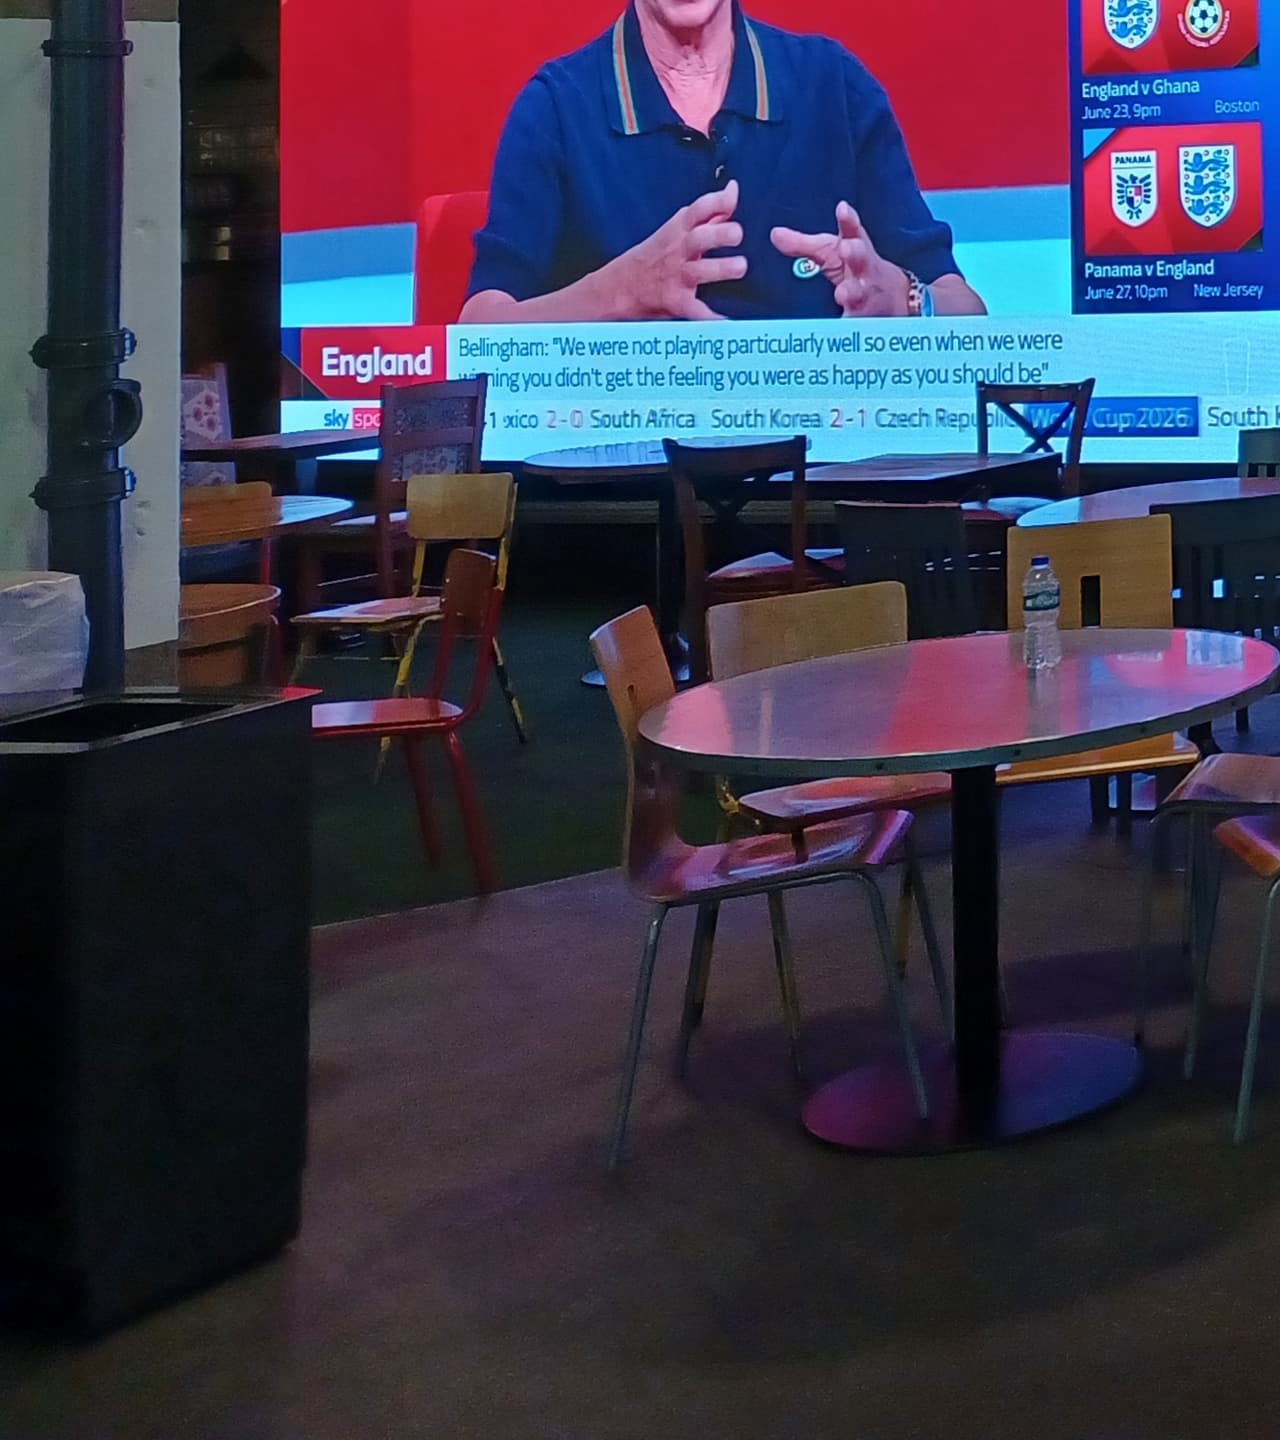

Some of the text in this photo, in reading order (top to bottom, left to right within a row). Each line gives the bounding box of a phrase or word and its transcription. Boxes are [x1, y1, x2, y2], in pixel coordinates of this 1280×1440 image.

[1082, 79, 1200, 101] England v Ghana
[1081, 106, 1110, 120] June
[1133, 103, 1161, 120] 9pm
[1215, 99, 1260, 113] Boston
[1084, 259, 1215, 280] Panama v England
[1084, 286, 1114, 300] June
[1135, 284, 1168, 300] 10pm
[1193, 283, 1264, 300] New Jersey
[459, 331, 1063, 362] Bellingham: "We were not playing particularly well so even when we were
[321, 346, 432, 383] England
[524, 373, 552, 392] you
[554, 366, 602, 387] didn't
[606, 369, 632, 392] get
[636, 367, 665, 387] the
[668, 366, 725, 392] feeling
[728, 371, 759, 391] you
[762, 369, 805, 386] were
[808, 369, 829, 385] as
[833, 364, 888, 390] happy
[891, 368, 912, 385] as
[916, 368, 949, 389] you
[952, 362, 1013, 383] should
[1018, 362, 1049, 383] be"
[323, 409, 349, 430] sky
[590, 409, 641, 428] South
[646, 408, 695, 428] Africa
[711, 409, 765, 428] South
[770, 408, 822, 428] Korea
[875, 408, 929, 428] Czech
[1092, 407, 1131, 432] Cup
[1136, 406, 1194, 428] 2026
[1208, 406, 1268, 427] South
